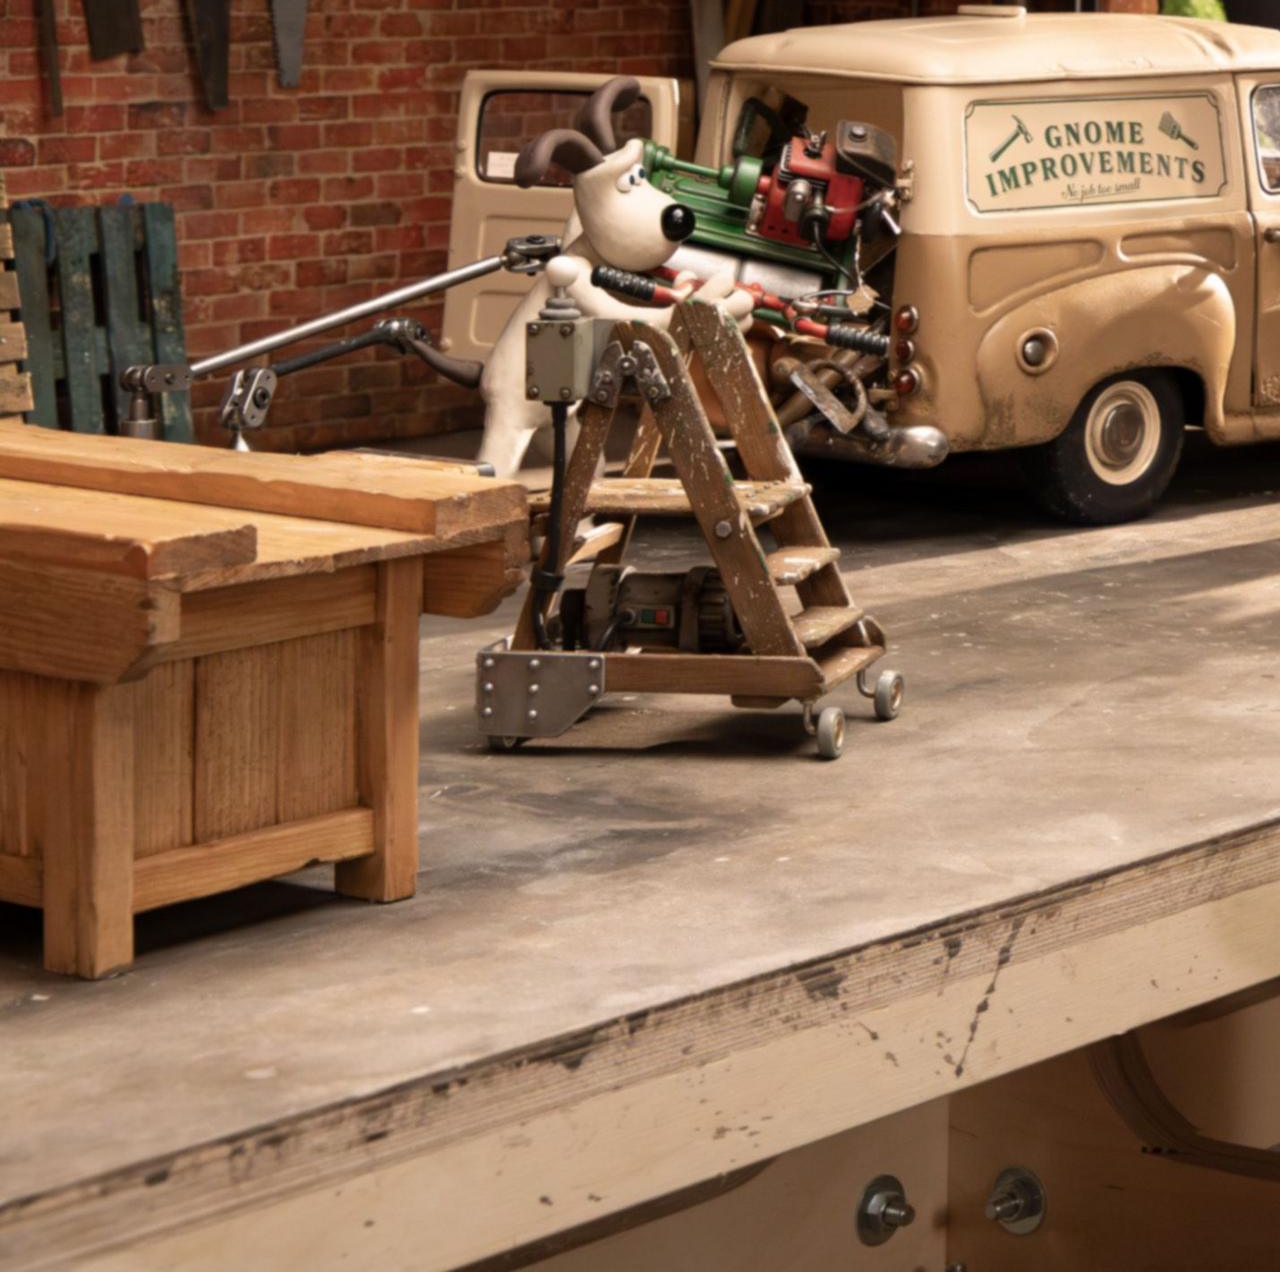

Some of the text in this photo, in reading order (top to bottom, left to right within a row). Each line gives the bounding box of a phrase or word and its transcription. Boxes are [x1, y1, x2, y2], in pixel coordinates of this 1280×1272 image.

[1044, 120, 1145, 149] GNOME
[984, 151, 1206, 197] IMPROVEMENTS
[1061, 184, 1079, 200] No
[1080, 183, 1096, 203] job
[1115, 177, 1141, 192] small
